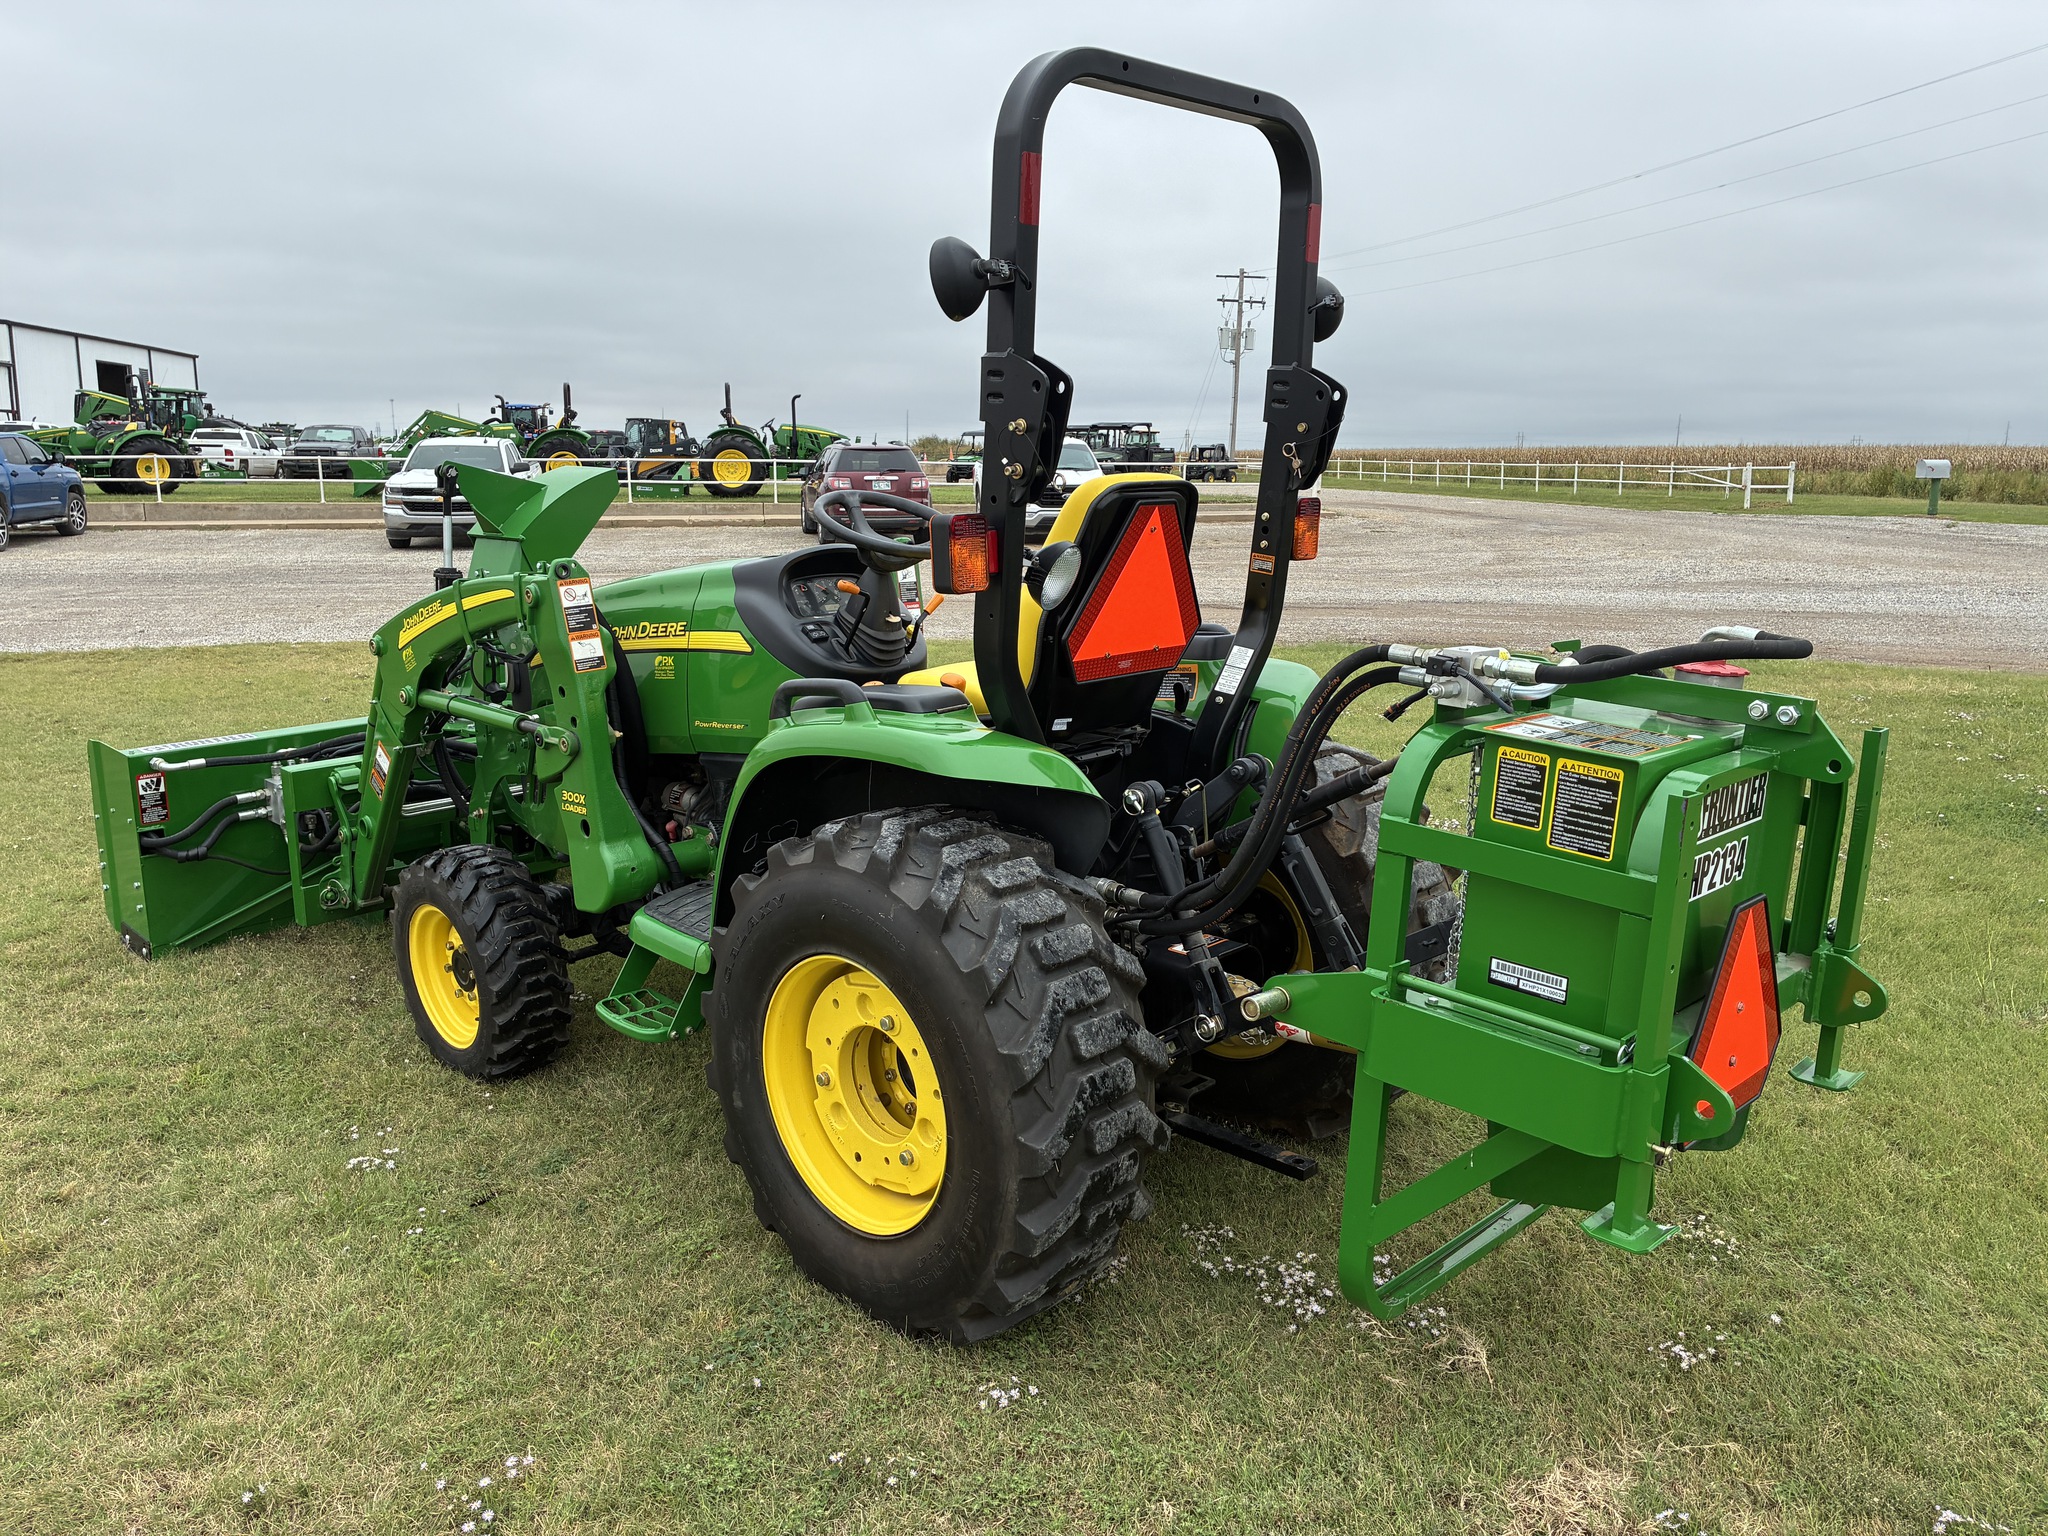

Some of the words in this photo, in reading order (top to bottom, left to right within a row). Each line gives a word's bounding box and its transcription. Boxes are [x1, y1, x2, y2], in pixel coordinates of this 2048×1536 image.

[402, 613, 420, 632] JOHN
[418, 600, 442, 623] DEERE
[610, 624, 637, 639] OHN
[638, 622, 688, 638] DEERE
[695, 720, 744, 729] PowrReverser
[1508, 750, 1546, 764] CAUTION
[1570, 763, 1620, 779] ATTENTION
[562, 790, 585, 804] 300X
[1702, 772, 1768, 830] FRONTIER
[562, 803, 587, 815] LOADER
[1690, 839, 1746, 898] HP2134
